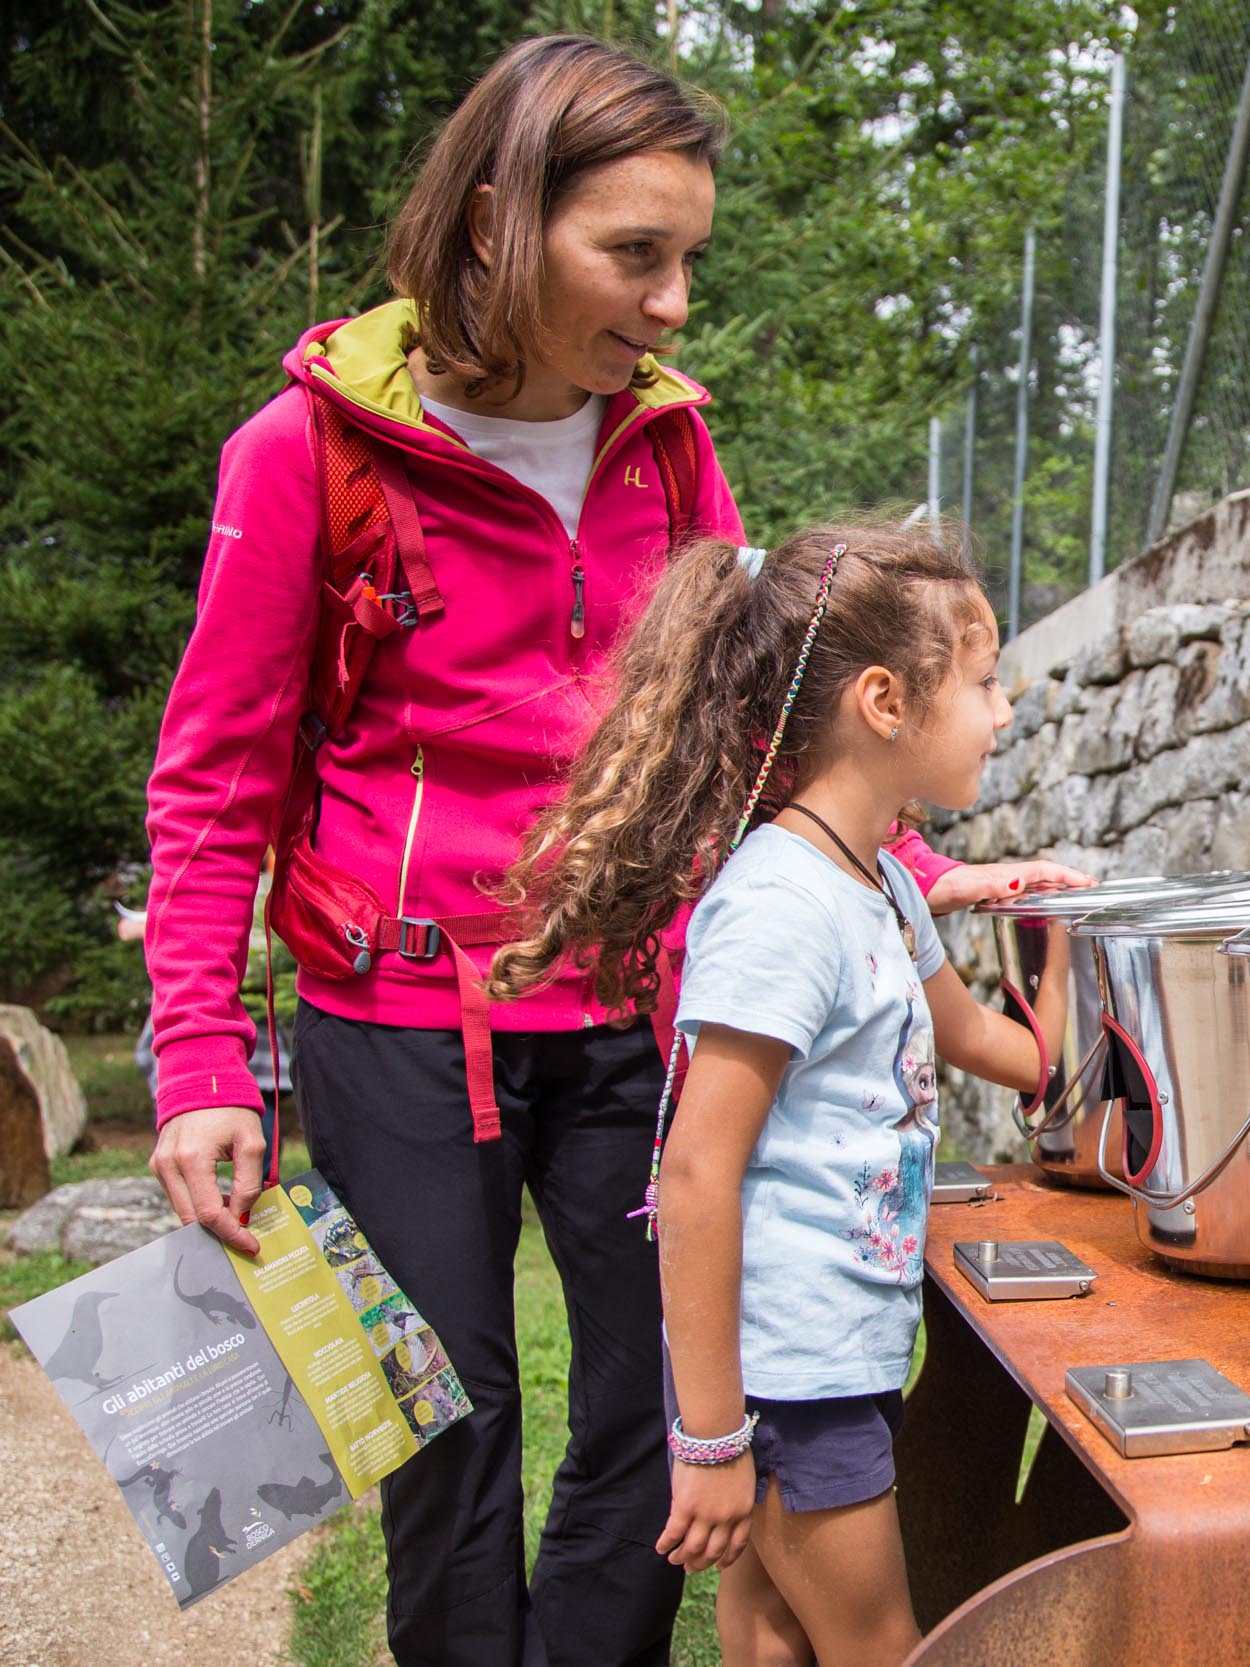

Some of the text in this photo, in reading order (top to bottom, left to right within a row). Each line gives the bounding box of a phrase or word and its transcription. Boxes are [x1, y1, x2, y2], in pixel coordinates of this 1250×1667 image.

[102, 1394, 126, 1415] Gli
[126, 1361, 185, 1403] abitanti
[186, 1348, 209, 1372] del
[208, 1333, 246, 1360] bosco
[246, 1523, 269, 1542] BOSCO
